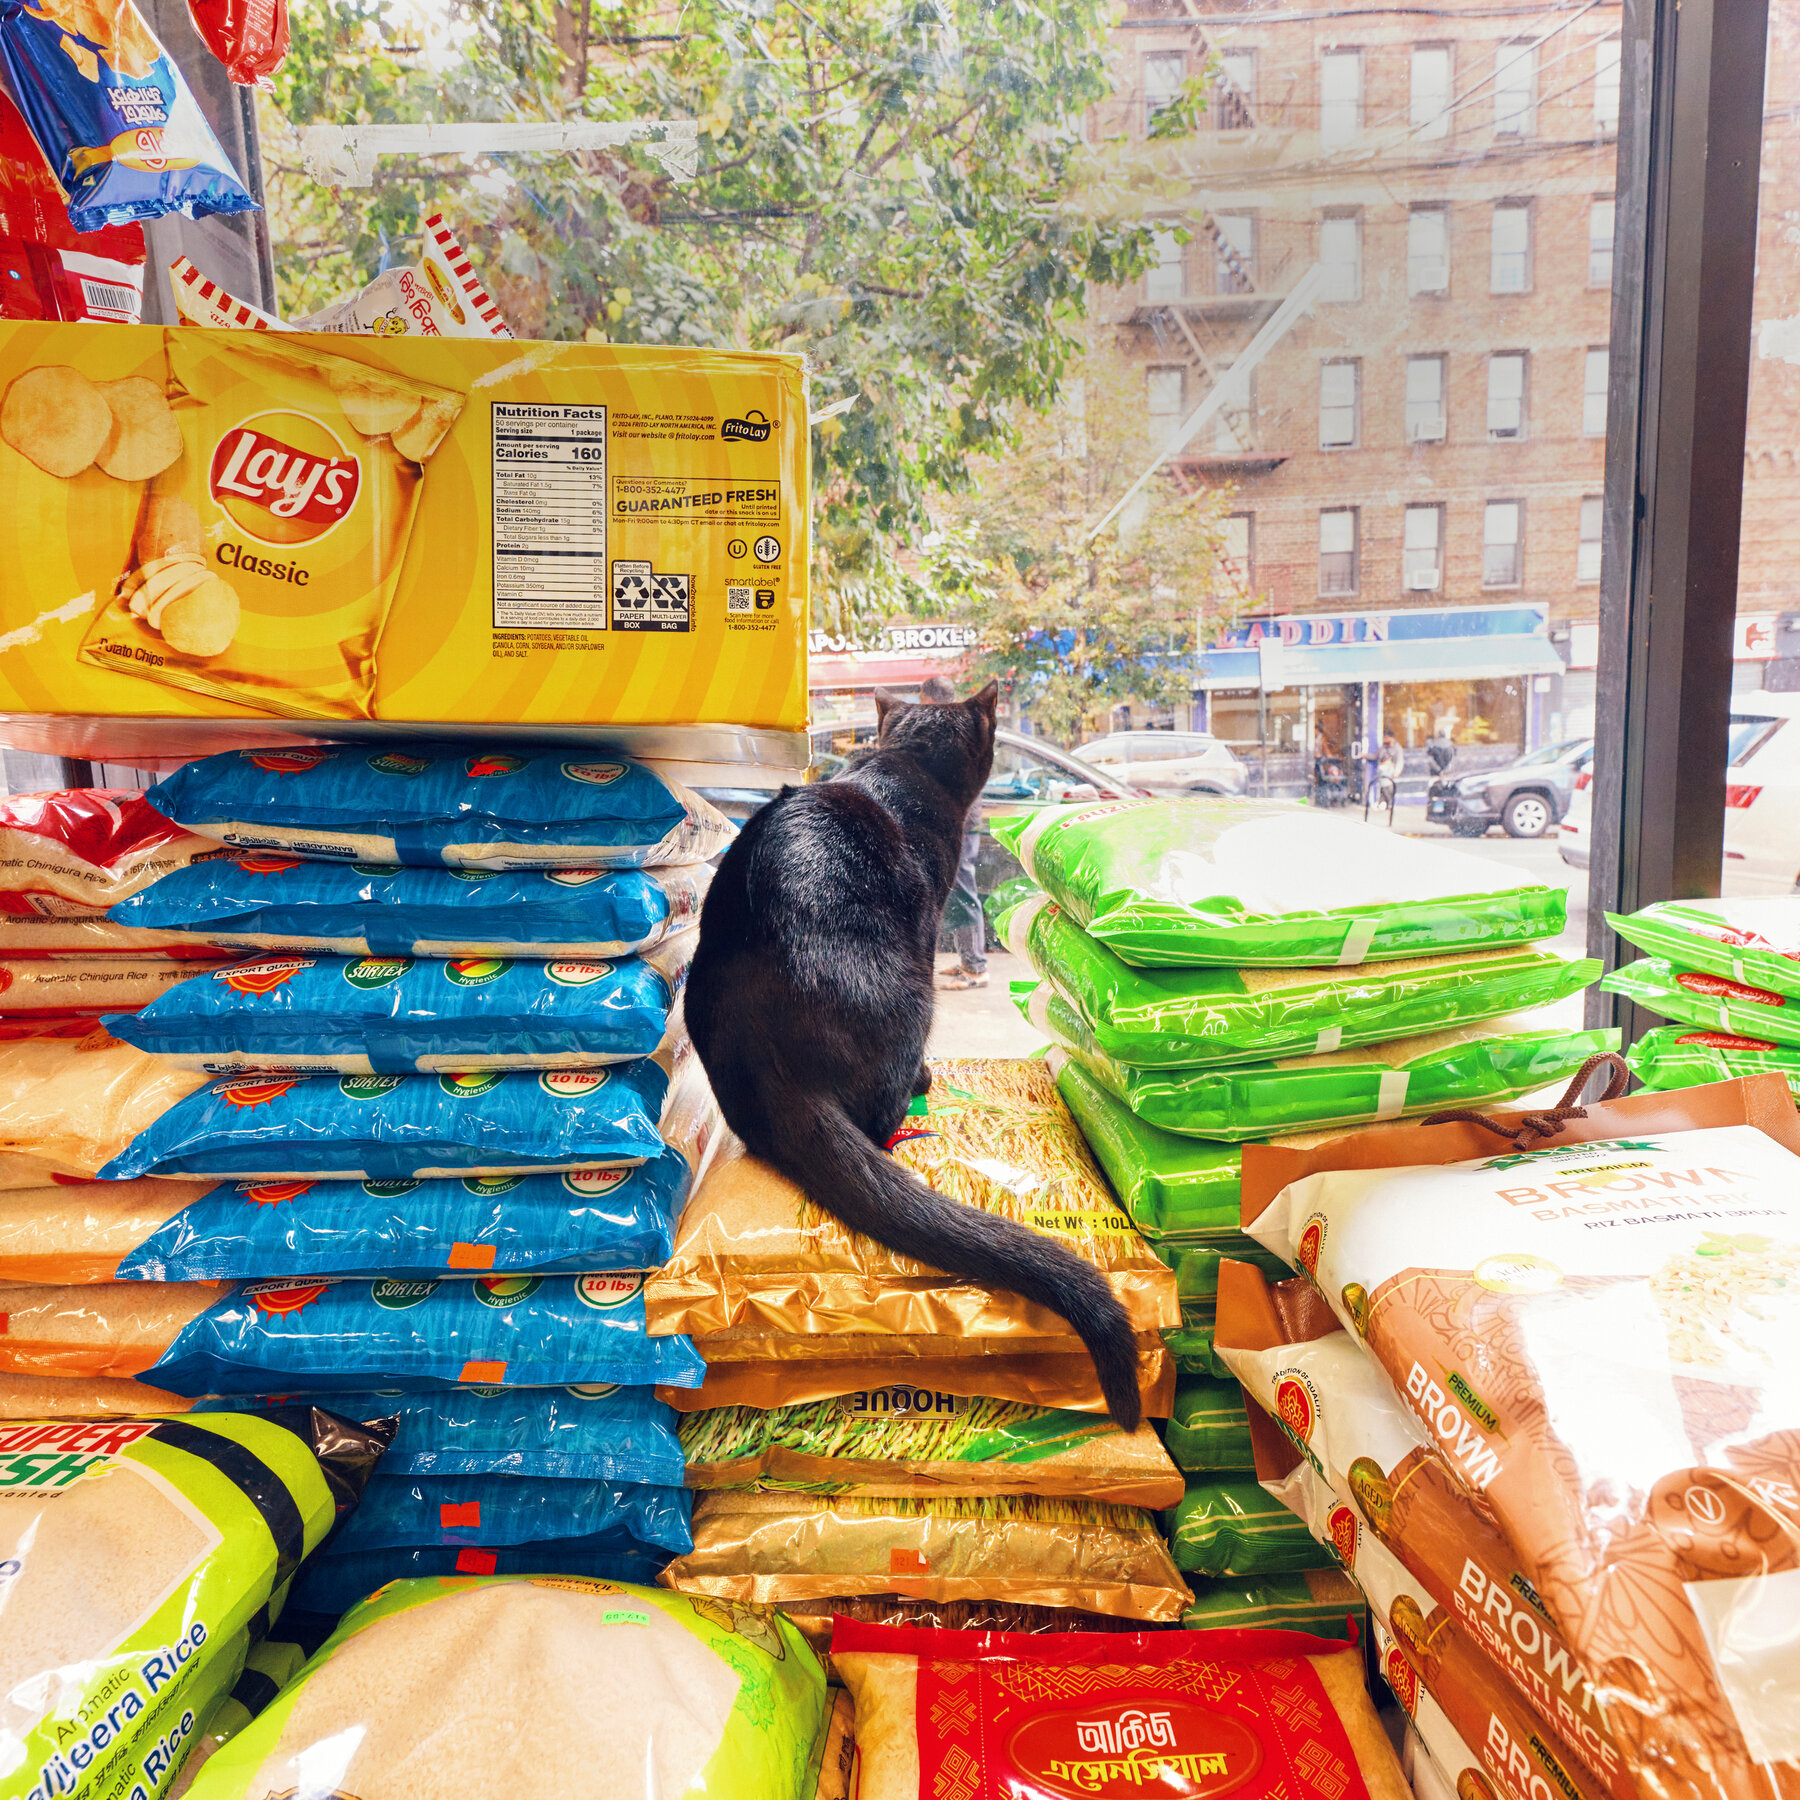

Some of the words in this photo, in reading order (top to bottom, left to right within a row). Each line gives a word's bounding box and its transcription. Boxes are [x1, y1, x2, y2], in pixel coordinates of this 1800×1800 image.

[496, 407, 559, 417] Nutrition
[564, 409, 602, 418] Facts
[726, 423, 749, 434] Frito
[750, 426, 766, 439] Lay
[496, 449, 548, 458] Calories
[572, 448, 601, 460] 160
[216, 431, 352, 518] Lay's
[616, 486, 686, 494] 1-800-352-4477
[617, 493, 722, 512] GUARANTEED
[727, 490, 776, 503] FRESH
[216, 542, 309, 587] Classic
[135, 648, 164, 666] Chips
[293, 841, 354, 852] BANGLADESH
[27, 860, 80, 878] Chinigura
[84, 872, 107, 884] Rice
[6, 915, 47, 924] Aromatic
[216, 966, 263, 978] EXPORT
[266, 960, 315, 972] QUALITY
[348, 964, 408, 980] SORTEX
[554, 965, 576, 974] 10
[580, 965, 602, 975] lbs
[35, 974, 77, 983] Aromatic
[79, 973, 124, 982] Chinigura
[458, 972, 498, 985] Hygienic
[216, 1080, 261, 1091] EXPORT
[344, 1076, 400, 1089] SORTEX
[550, 1075, 572, 1084] 10
[576, 1075, 599, 1084] lbs
[453, 1084, 492, 1096] Hygienic
[573, 1172, 594, 1181] 10
[597, 1171, 621, 1182] lbs
[1560, 1162, 1649, 1176] PREMIUM
[476, 1181, 516, 1195] Hygienic
[1530, 1192, 1700, 1222] BASMATI
[1034, 1216, 1060, 1229] Net
[1583, 1220, 1622, 1229] RIZ
[1624, 1211, 1722, 1226] BASMATI
[246, 1282, 293, 1296] EXPORT
[376, 1282, 434, 1296] SORTEX
[586, 1280, 604, 1292] 10
[608, 1280, 635, 1292] lbs
[488, 1291, 528, 1306] Hygienic
[853, 1388, 954, 1413] HOQUE
[1272, 1368, 1302, 1386] TRADITION
[1300, 1371, 1309, 1382] OF
[1306, 1380, 1322, 1420] QUALITY
[1448, 1374, 1497, 1430] PREMIUM
[1406, 1360, 1504, 1494] BROWN
[1358, 1479, 1384, 1508] AGED
[142, 1622, 208, 1694] Rice
[1453, 1590, 1550, 1704] BASMATI
[1556, 1696, 1619, 1774] RICE
[56, 1668, 130, 1744] Aromatic
[1076, 1710, 1177, 1754] আকিজ
[143, 1710, 194, 1786] Rice
[1563, 1724, 1612, 1790] BRUN
